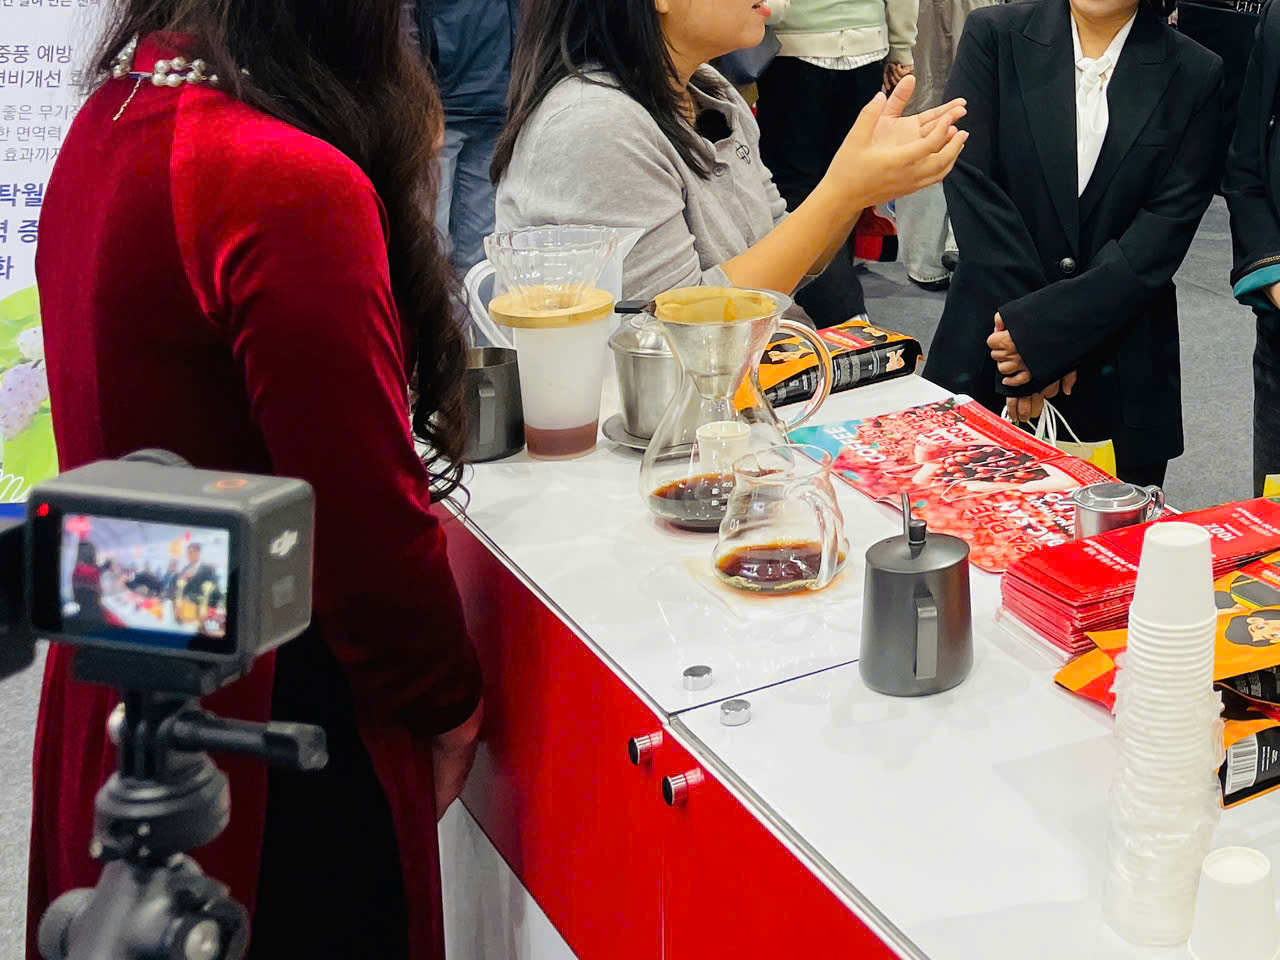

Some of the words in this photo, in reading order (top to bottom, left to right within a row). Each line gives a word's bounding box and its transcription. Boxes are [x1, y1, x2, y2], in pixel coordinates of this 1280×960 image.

[37, 44, 73, 64] 예방
[2, 104, 32, 120] 좋은
[17, 126, 61, 141] 면역력
[824, 424, 889, 462] COFFEE
